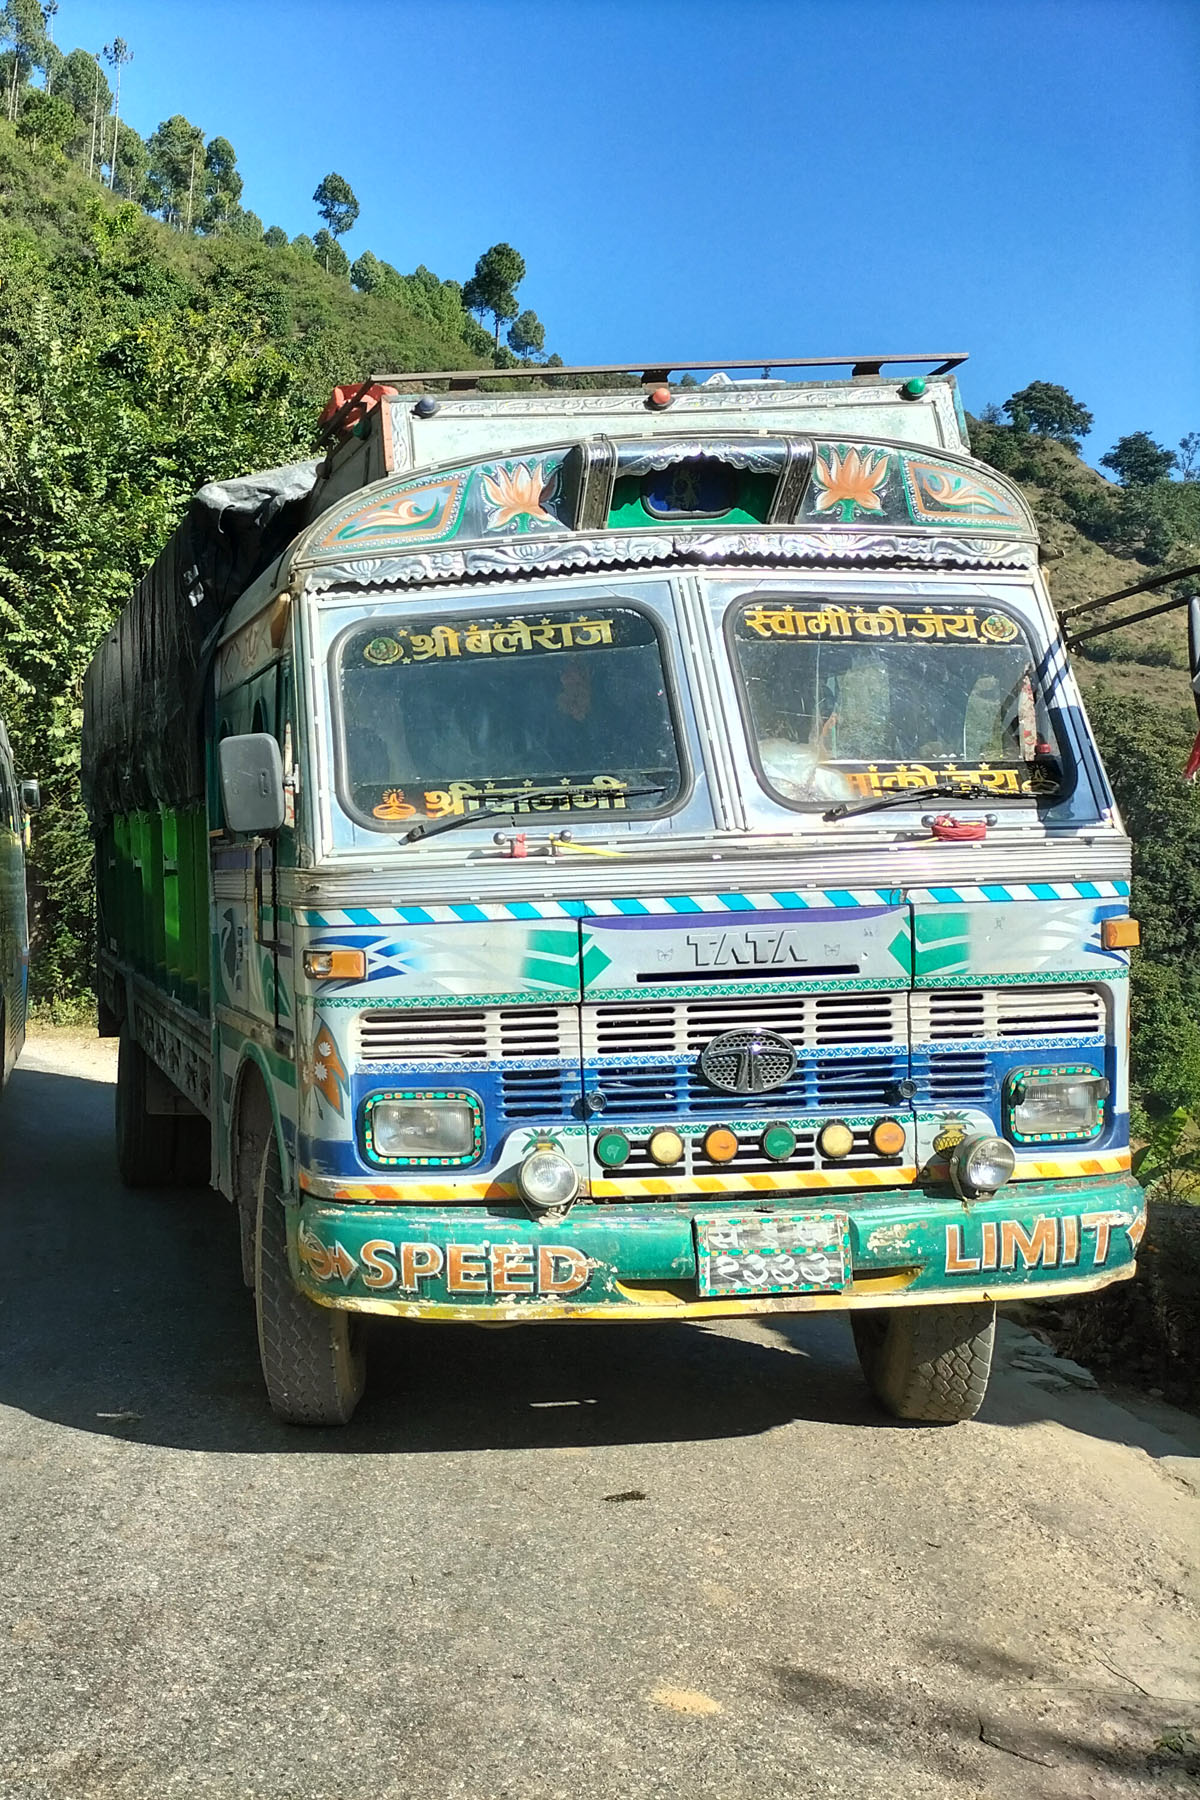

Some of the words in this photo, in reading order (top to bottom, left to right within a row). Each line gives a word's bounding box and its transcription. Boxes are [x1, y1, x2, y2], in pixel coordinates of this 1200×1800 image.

[410, 626, 461, 660] श्री
[686, 929, 808, 967] TATA
[359, 1238, 593, 1294] SPEED
[944, 1210, 1129, 1274] LIMIT
